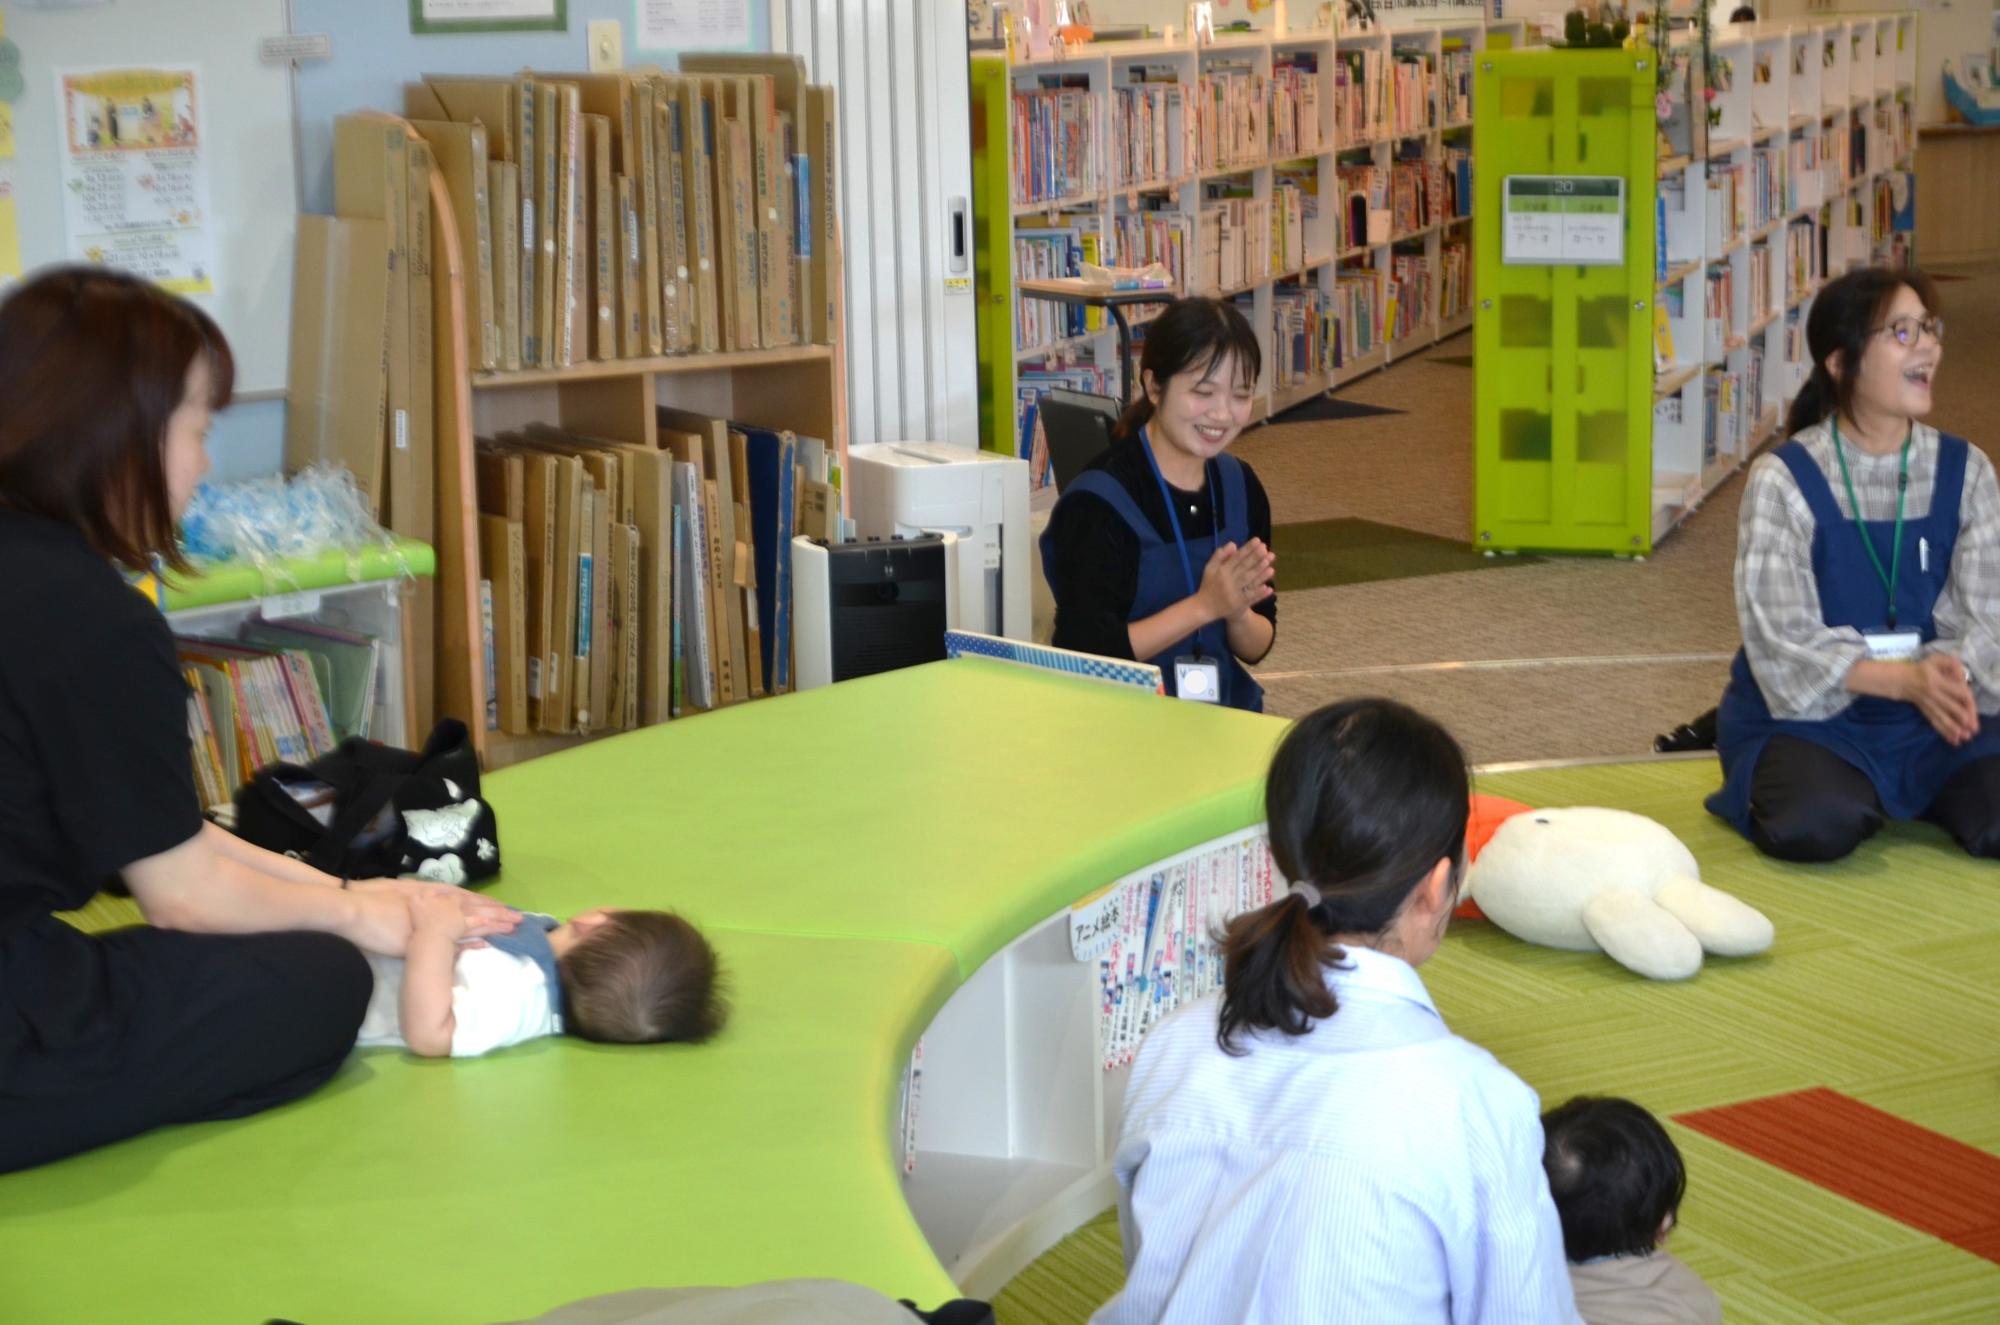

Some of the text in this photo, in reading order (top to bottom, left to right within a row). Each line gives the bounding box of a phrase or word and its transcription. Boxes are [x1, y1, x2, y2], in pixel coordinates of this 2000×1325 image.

[1075, 906, 1119, 943] アニメ絵本
